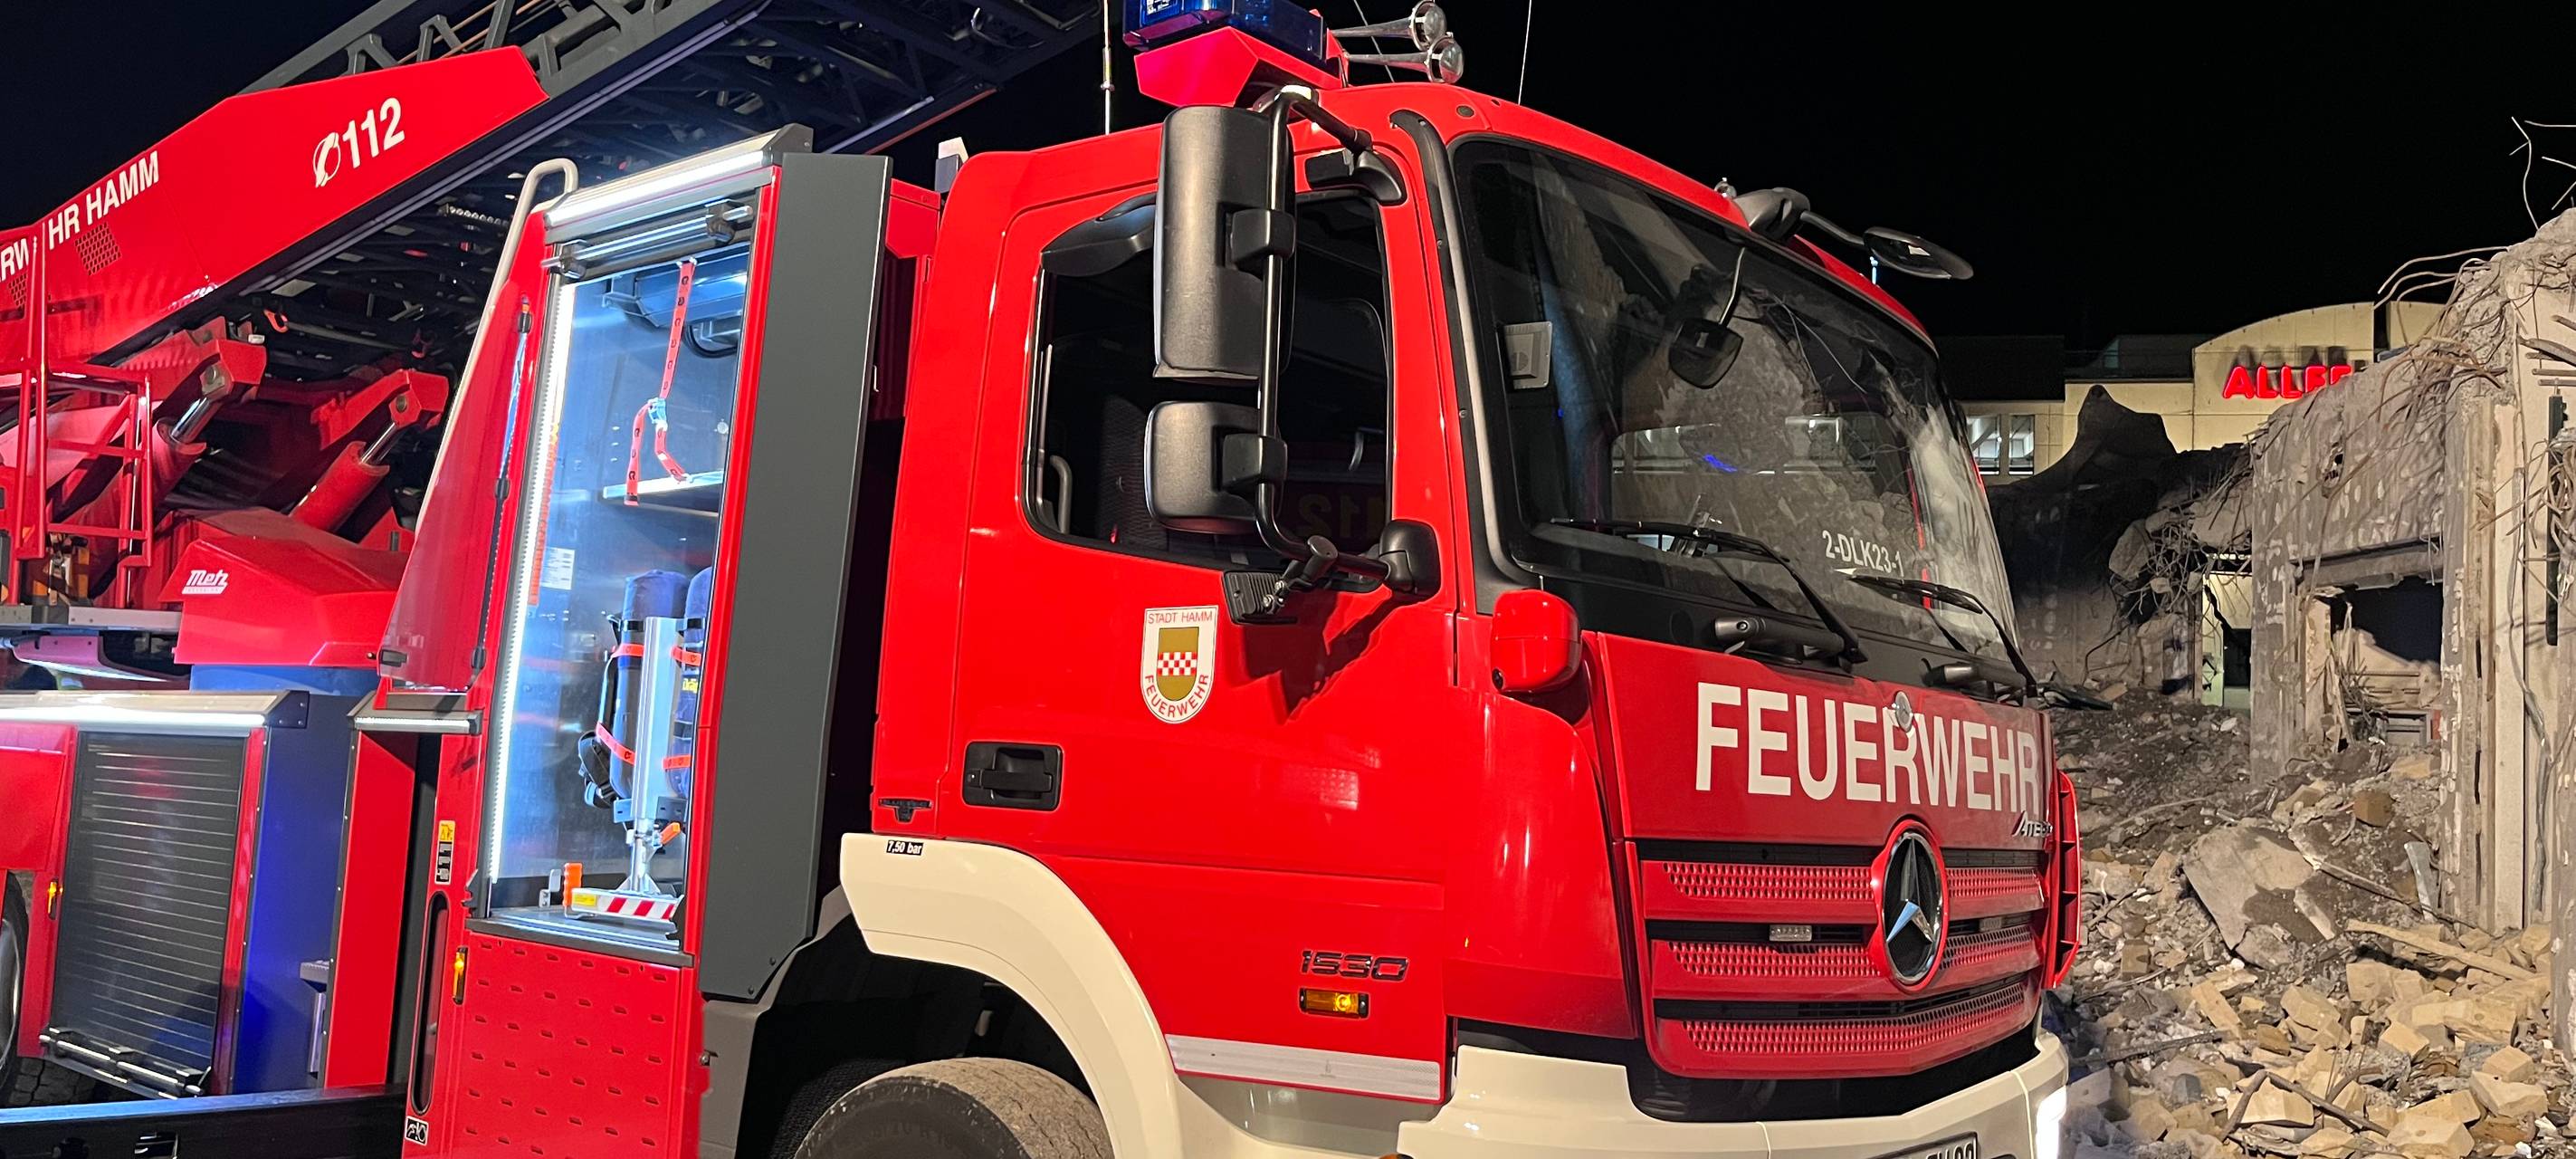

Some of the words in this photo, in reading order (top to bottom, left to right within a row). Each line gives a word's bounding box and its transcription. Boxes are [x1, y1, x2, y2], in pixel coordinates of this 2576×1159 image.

[342, 97, 405, 169] 112
[86, 150, 159, 225] HAMM
[1822, 530, 1904, 578] 2-DLK23-1
[1148, 612, 1178, 625] STADT
[1181, 610, 1213, 623] HAMM
[1144, 674, 1209, 718] FEUERWEHR
[1695, 682, 2040, 816] FEUERWEHR
[887, 840, 906, 853] 7,50
[907, 842, 922, 855] bar
[1302, 950, 1408, 982] 1530
